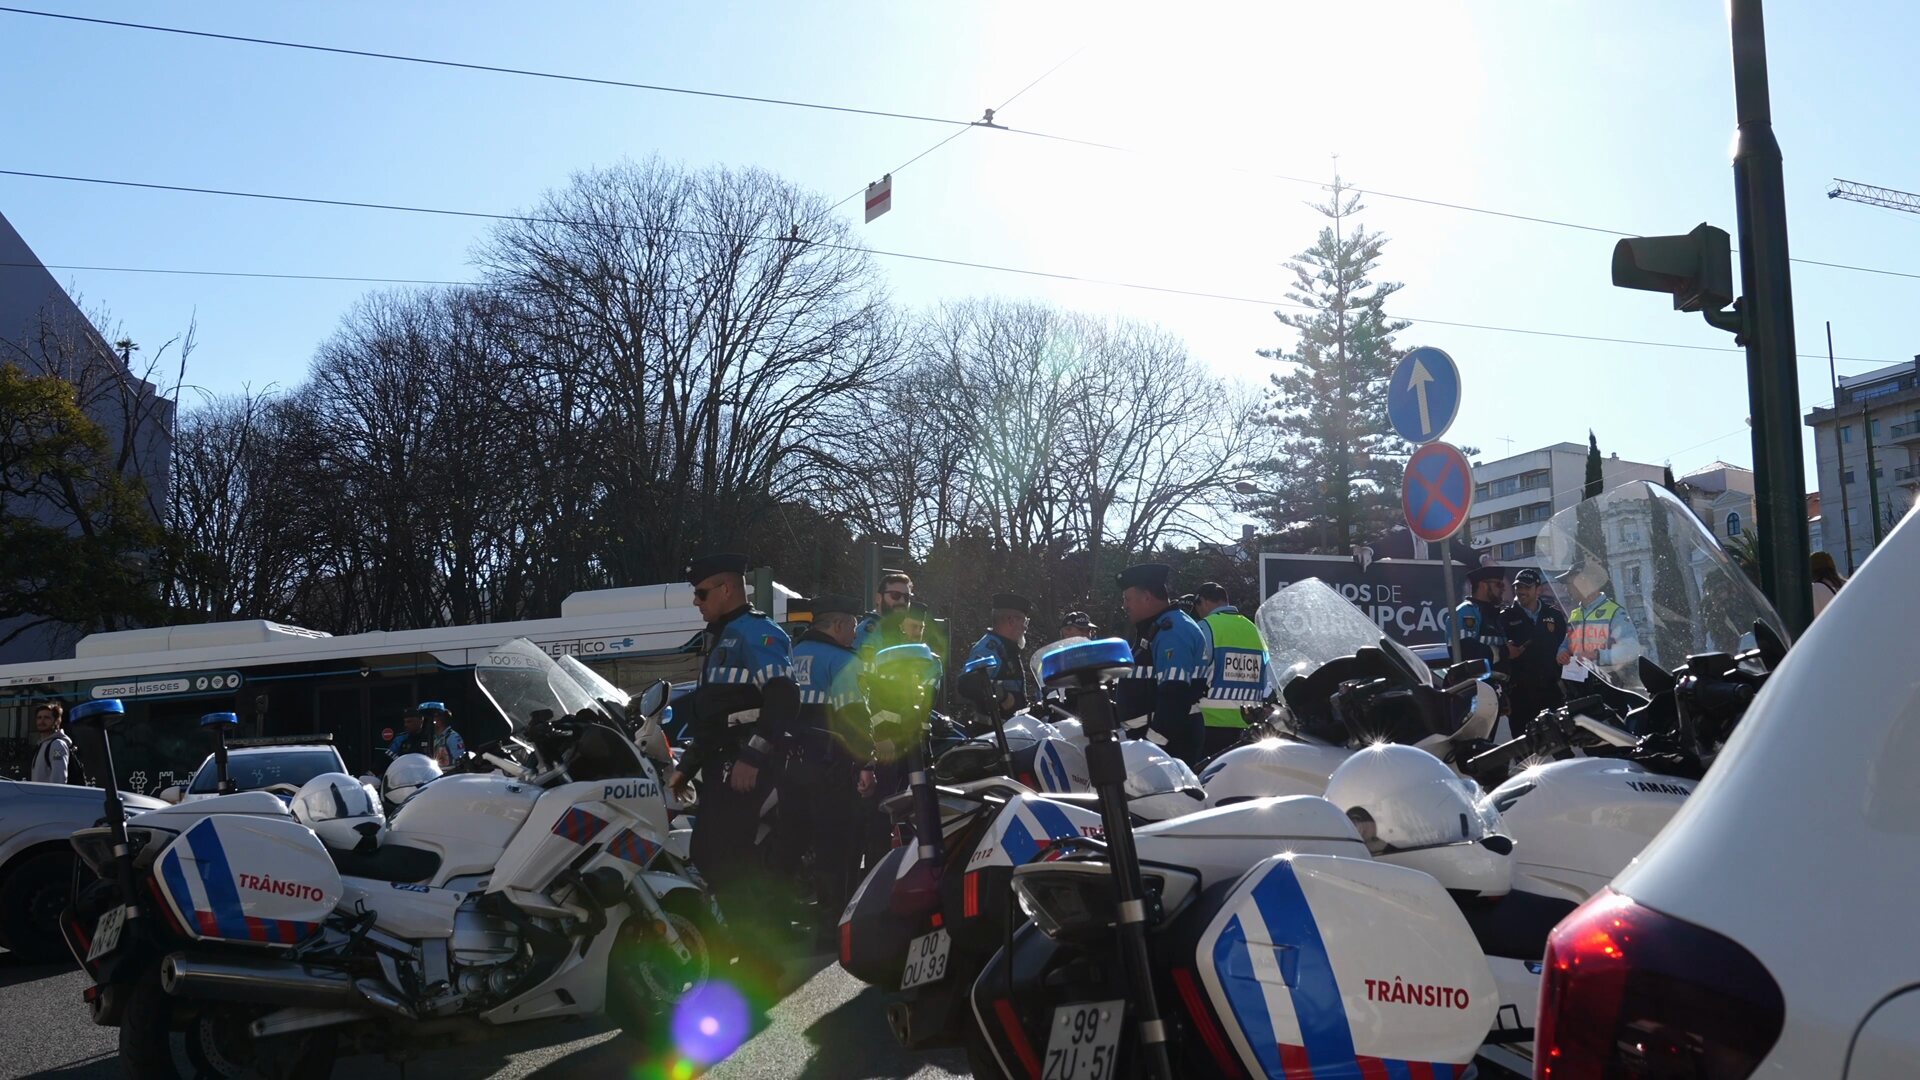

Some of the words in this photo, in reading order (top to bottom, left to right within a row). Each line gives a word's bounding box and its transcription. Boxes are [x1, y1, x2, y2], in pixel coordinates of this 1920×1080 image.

[1376, 584, 1402, 603] DE
[489, 655, 521, 665] 100%
[1225, 655, 1259, 672] POLÍCIA
[102, 687, 126, 696] ZERO
[603, 780, 659, 800] POLÍCIA
[1625, 781, 1691, 797] YAMAHA
[239, 874, 324, 902] TRÂNSITO
[1364, 975, 1470, 1010] TRÂNSITO
[1071, 1008, 1100, 1045] 99
